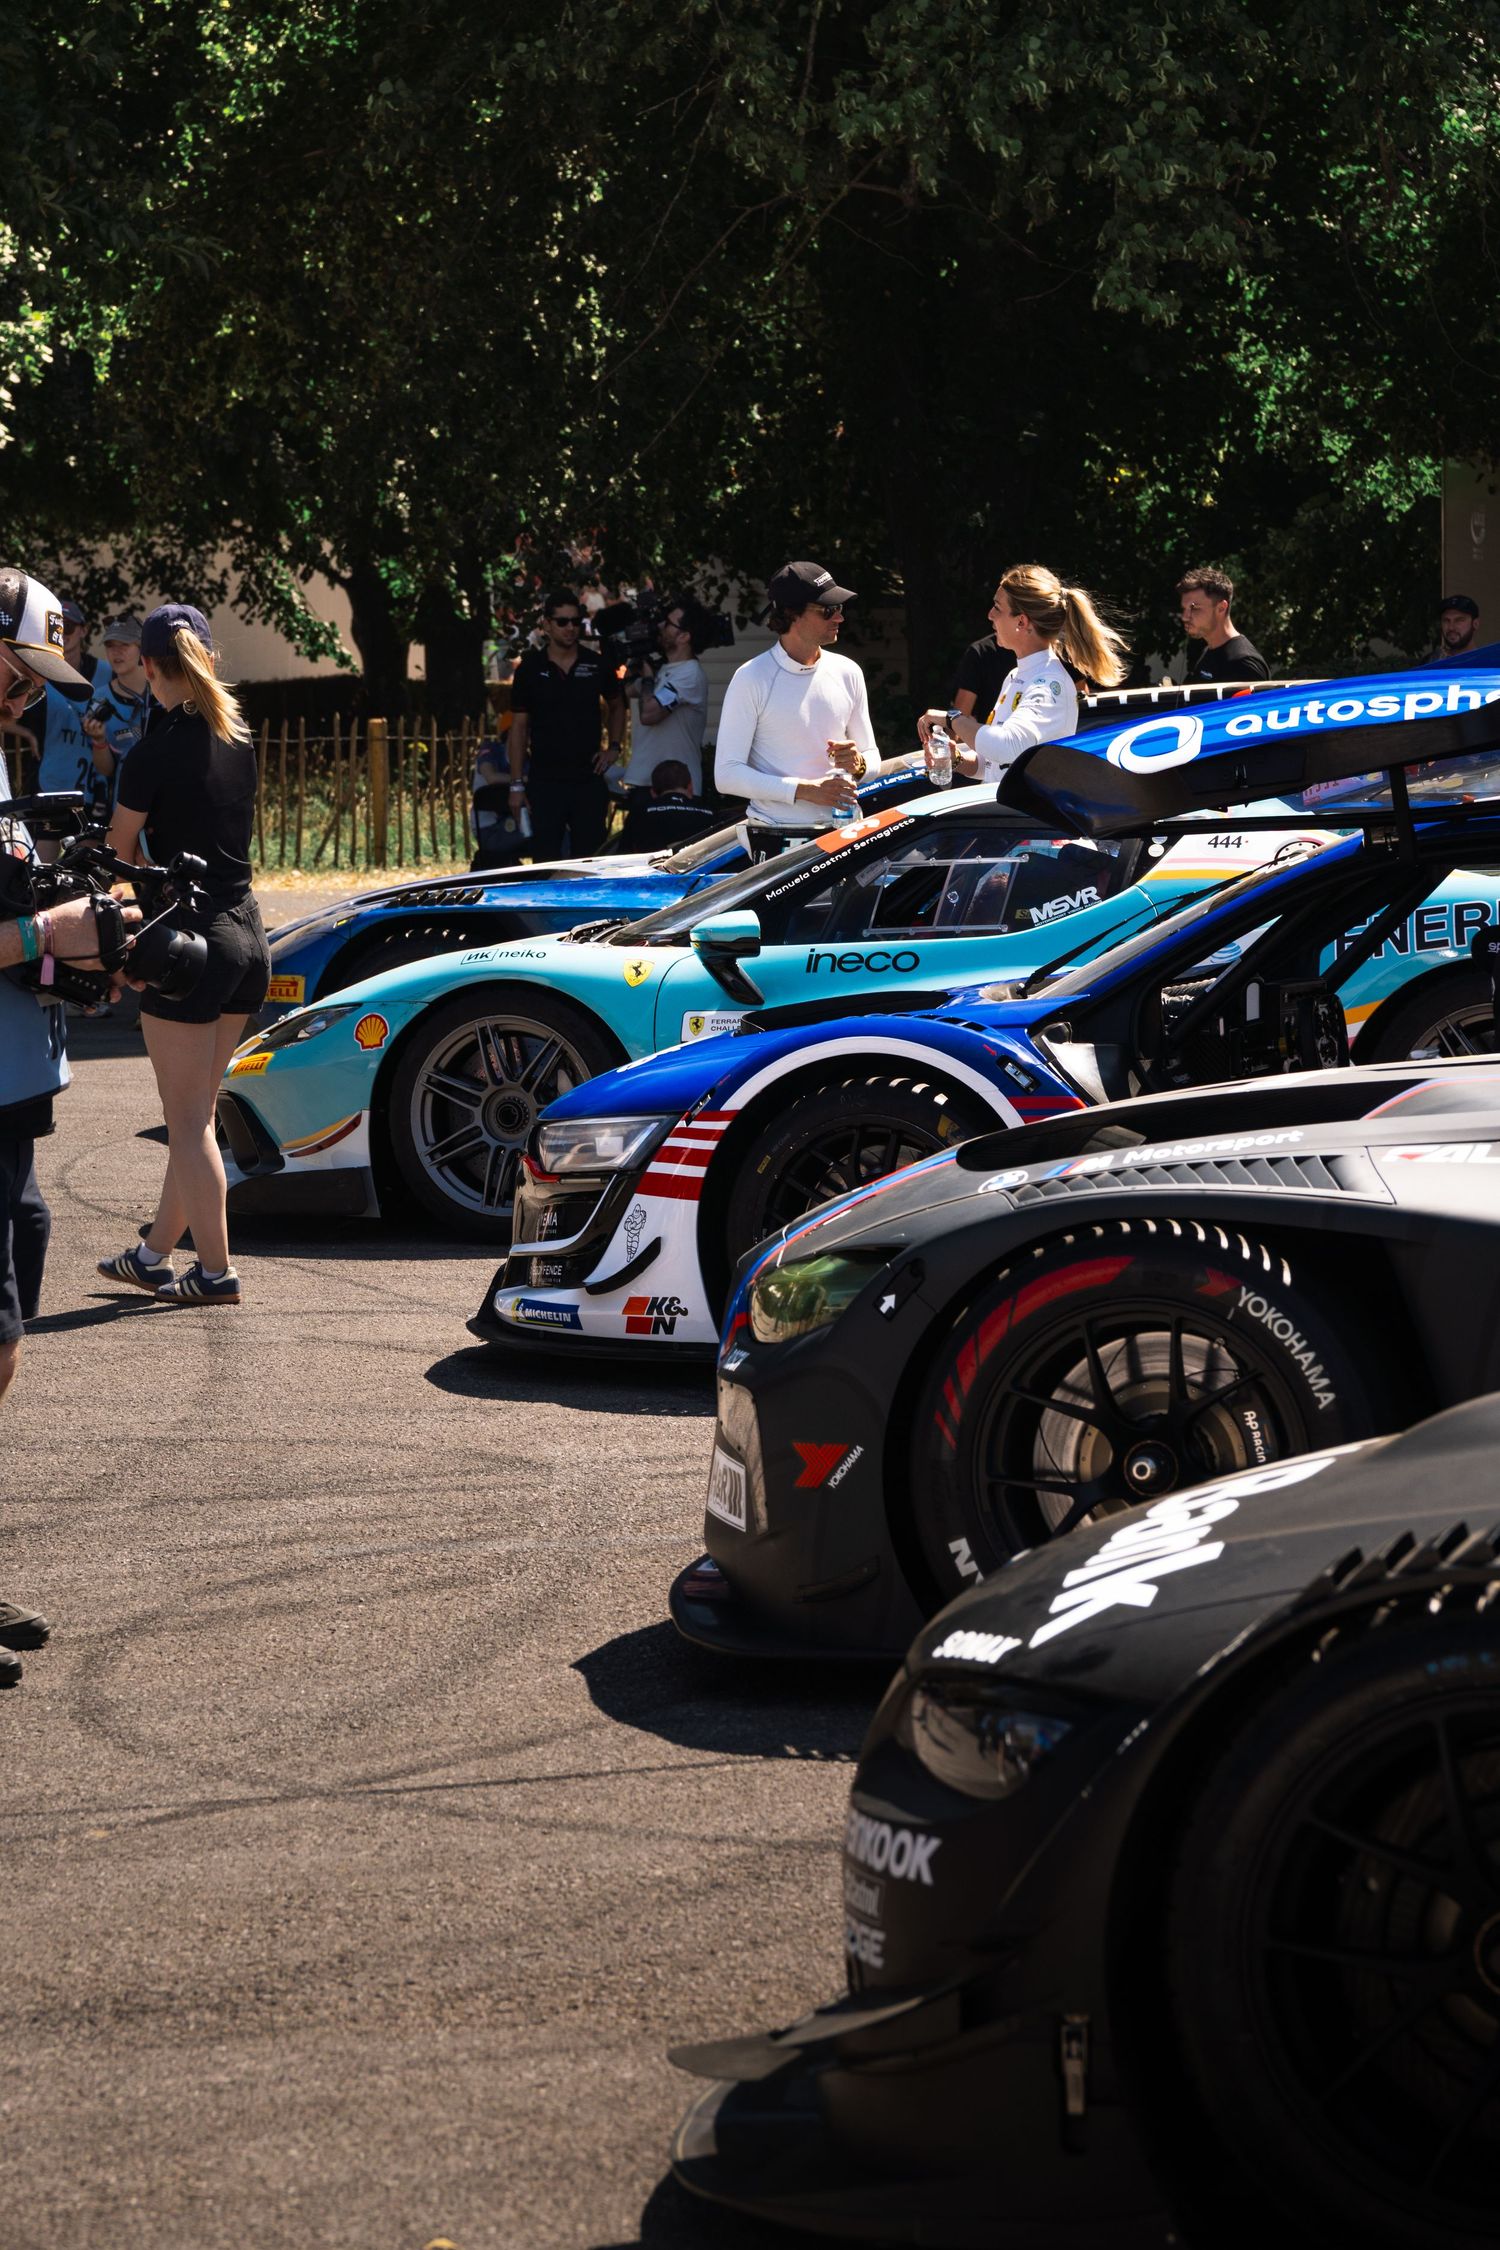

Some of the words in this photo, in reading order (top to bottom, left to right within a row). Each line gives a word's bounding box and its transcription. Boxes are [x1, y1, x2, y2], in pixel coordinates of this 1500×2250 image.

[1207, 834, 1242, 848] 444
[765, 872, 810, 901] Manuela
[811, 848, 852, 873] Gostner
[1029, 886, 1101, 923] MSVR
[499, 949, 547, 959] neiko
[805, 948, 920, 974] ineco
[269, 988, 298, 999] ELLI
[711, 1018, 742, 1026] FERRAR
[1123, 1130, 1304, 1164] Motorsport
[525, 1308, 572, 1323] MICHELIN
[1238, 1285, 1336, 1410] YOKOHAMA
[1253, 1430, 1266, 1463] RACIN
[828, 1444, 864, 1488] YOKOHAMA
